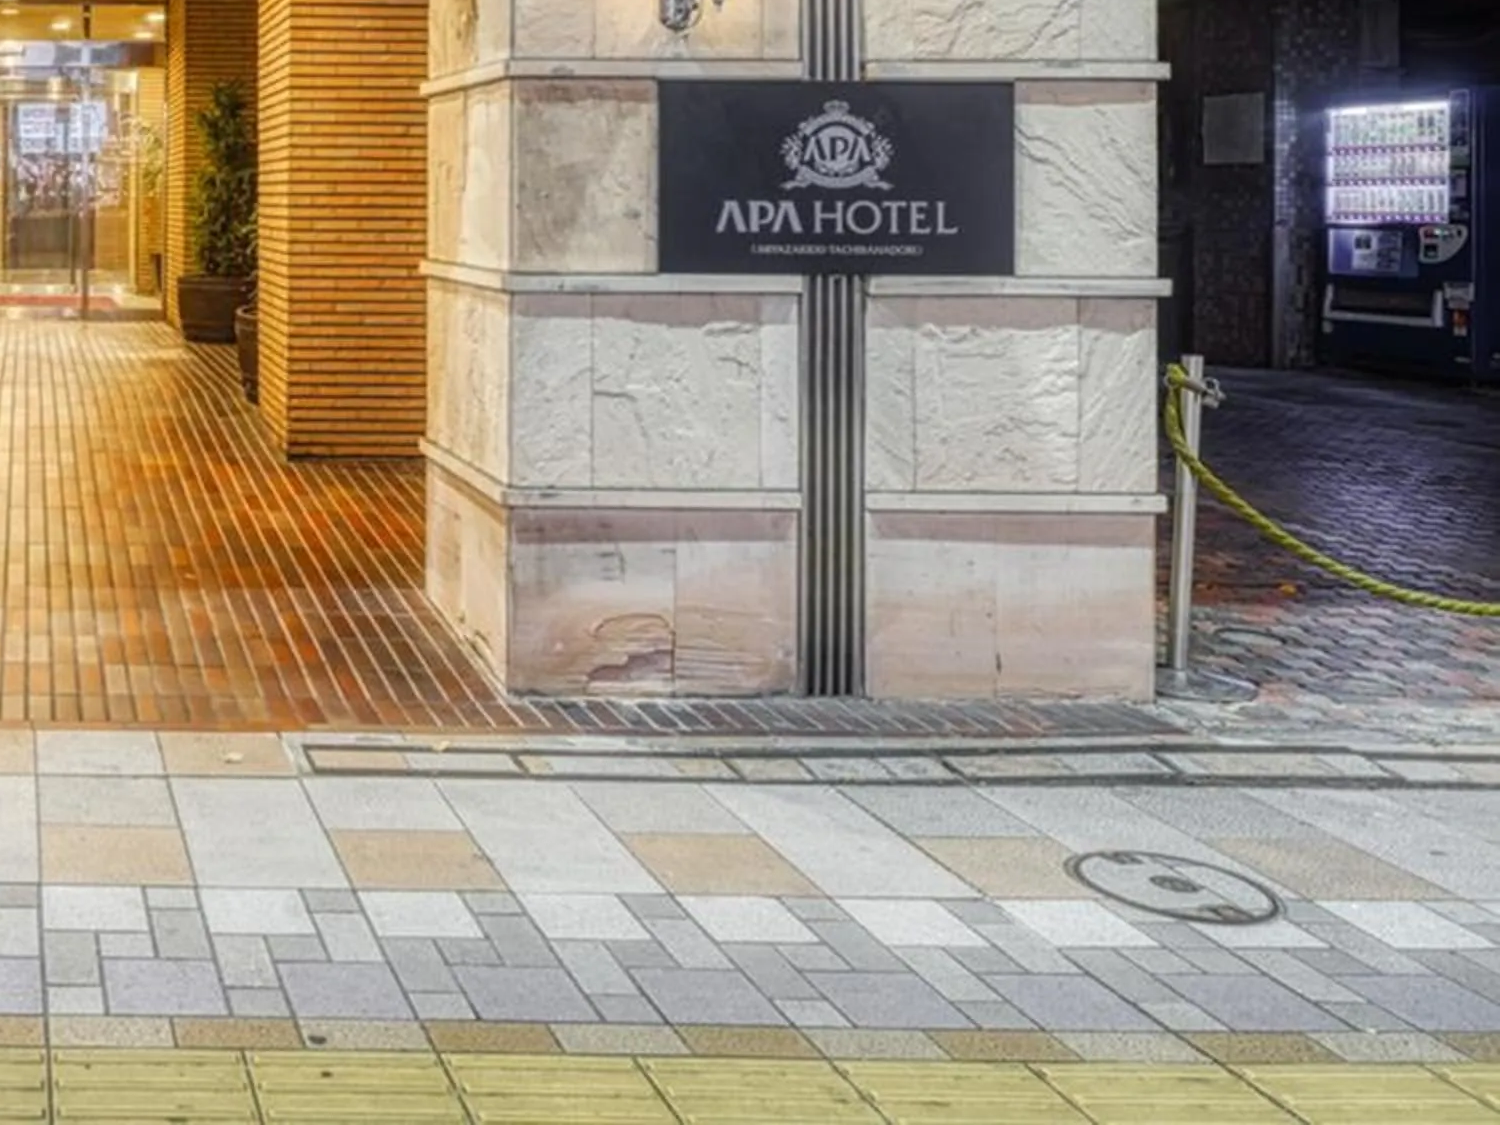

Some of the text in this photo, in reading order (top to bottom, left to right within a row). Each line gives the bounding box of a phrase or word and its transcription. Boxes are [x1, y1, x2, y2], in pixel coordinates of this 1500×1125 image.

[804, 136, 871, 162] APA
[716, 200, 959, 234] APA HOTEL
